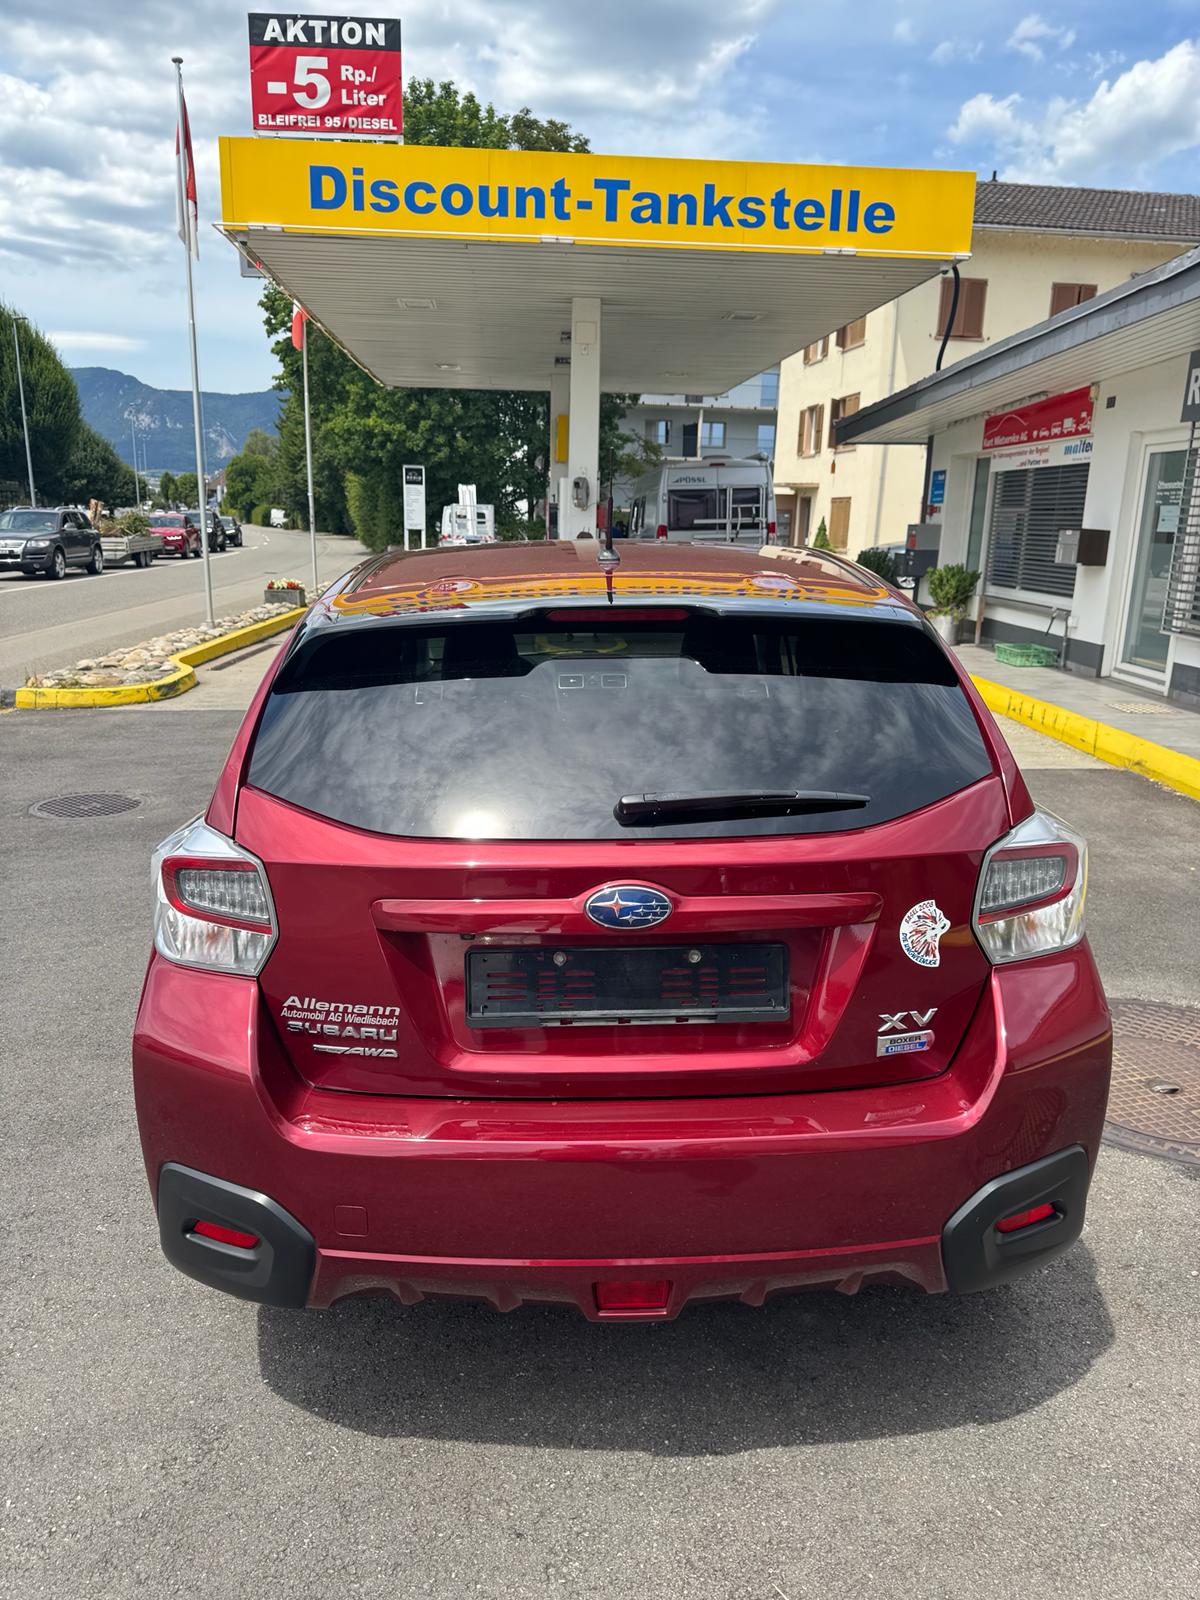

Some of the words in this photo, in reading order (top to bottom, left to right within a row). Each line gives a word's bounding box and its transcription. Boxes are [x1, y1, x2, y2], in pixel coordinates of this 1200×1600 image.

[263, 18, 386, 46] AKTION
[267, 56, 331, 109] -5
[340, 65, 377, 85] Rp./
[341, 89, 387, 106] Liter
[258, 114, 320, 127] BLEIFREI
[309, 165, 895, 234] Discount-Tankstelle
[283, 996, 400, 1016] Allemann
[281, 1008, 326, 1020] Automobil
[328, 1013, 342, 1022] AG
[344, 1014, 399, 1026] Wiedlisbach
[878, 1008, 938, 1032] XV
[287, 1021, 398, 1041] SUBARU
[890, 1036, 921, 1045] BOXER
[343, 1047, 398, 1058] AWD
[888, 1042, 924, 1053] DIESEL
